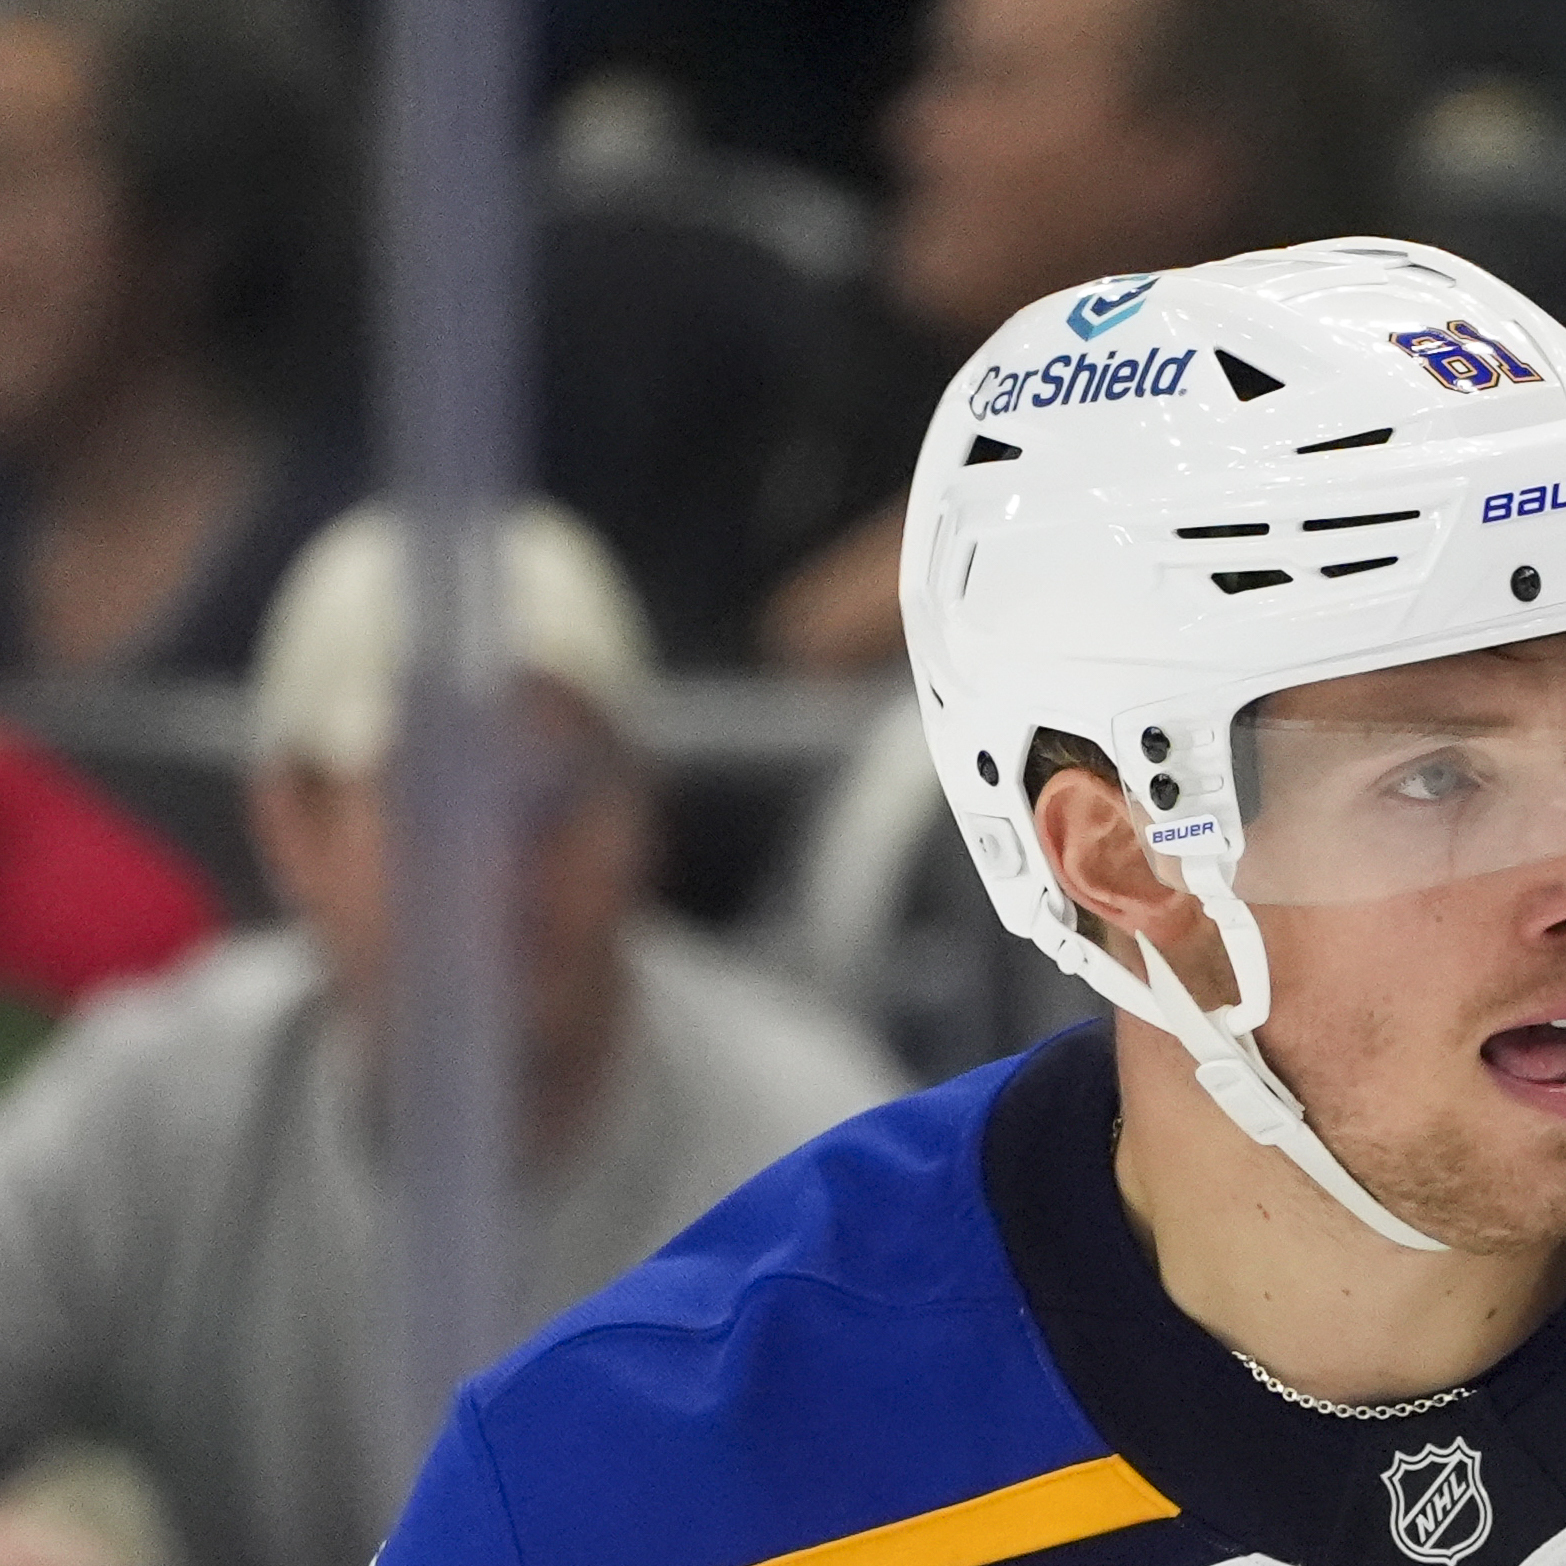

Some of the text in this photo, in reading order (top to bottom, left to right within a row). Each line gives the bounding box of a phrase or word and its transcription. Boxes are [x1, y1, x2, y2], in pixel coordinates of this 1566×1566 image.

[969, 347, 1198, 422] CarShield
[1388, 320, 1545, 394] 81
[1152, 821, 1215, 844] BAUER
[1415, 1471, 1467, 1544] NHL
